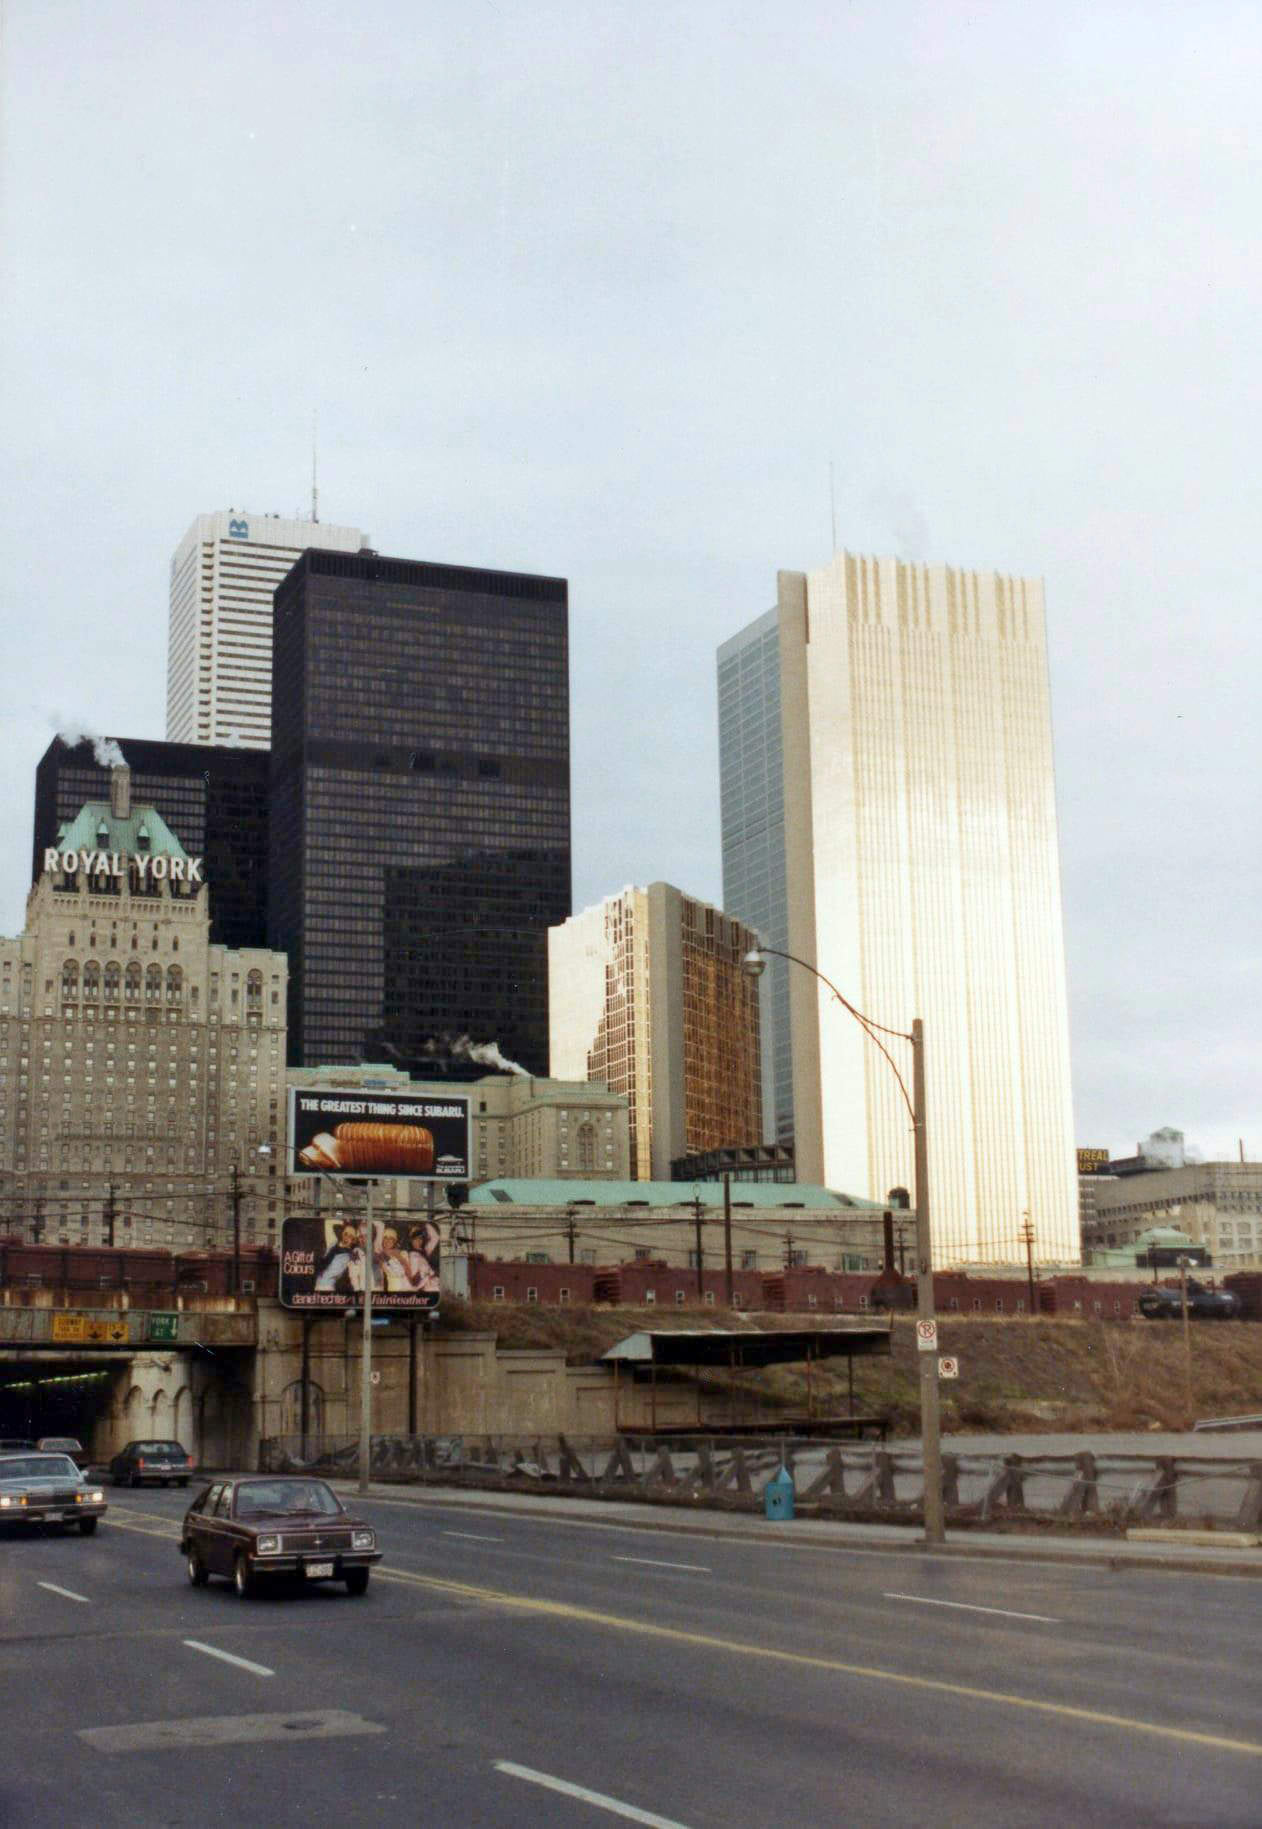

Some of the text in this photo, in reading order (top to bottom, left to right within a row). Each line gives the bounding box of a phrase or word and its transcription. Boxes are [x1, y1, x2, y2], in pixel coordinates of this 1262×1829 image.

[44, 848, 203, 882] ROYAL YORK
[300, 1099, 464, 1118] THE GREATEST THING SINCE SUBARU.
[283, 1262, 315, 1274] Colours
